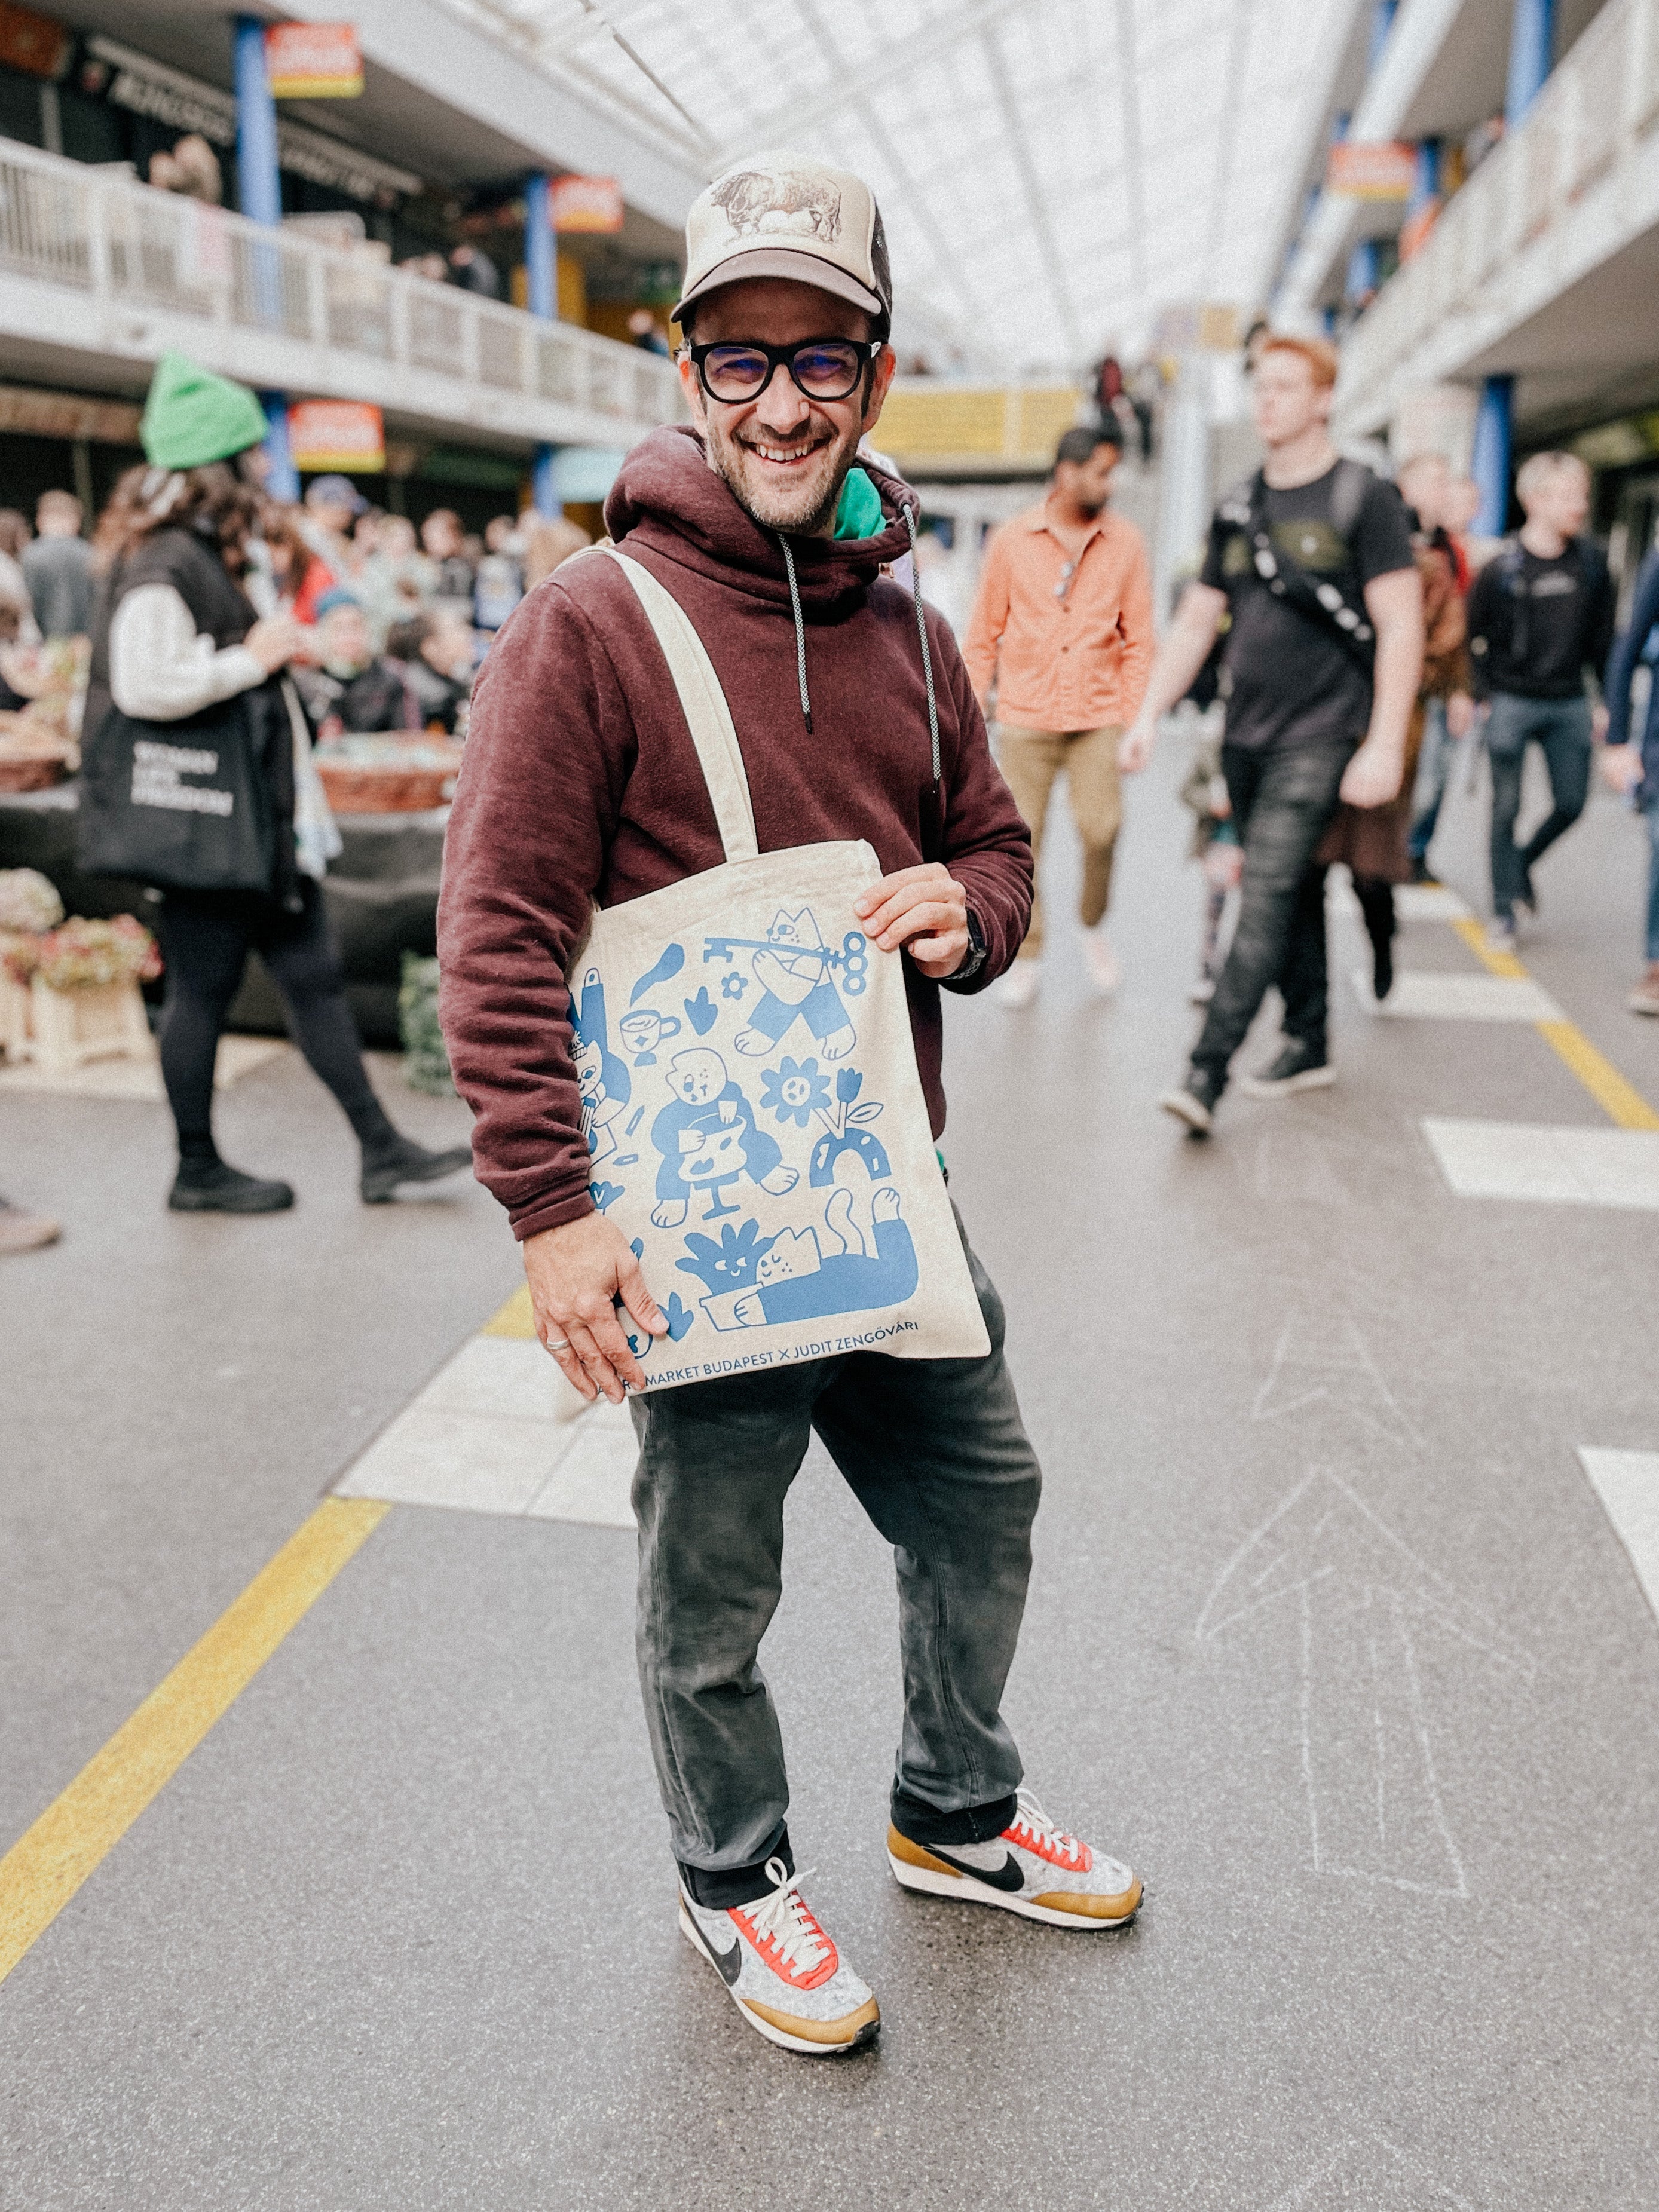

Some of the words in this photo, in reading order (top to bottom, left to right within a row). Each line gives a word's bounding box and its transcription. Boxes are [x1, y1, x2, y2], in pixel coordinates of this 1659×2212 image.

[645, 1365, 699, 1386] MARKET
[703, 1352, 773, 1375] BUDAPEST
[778, 1348, 790, 1361] X
[794, 1340, 831, 1358] JUDIT
[835, 1321, 918, 1350] ZENGŐVÁRI
